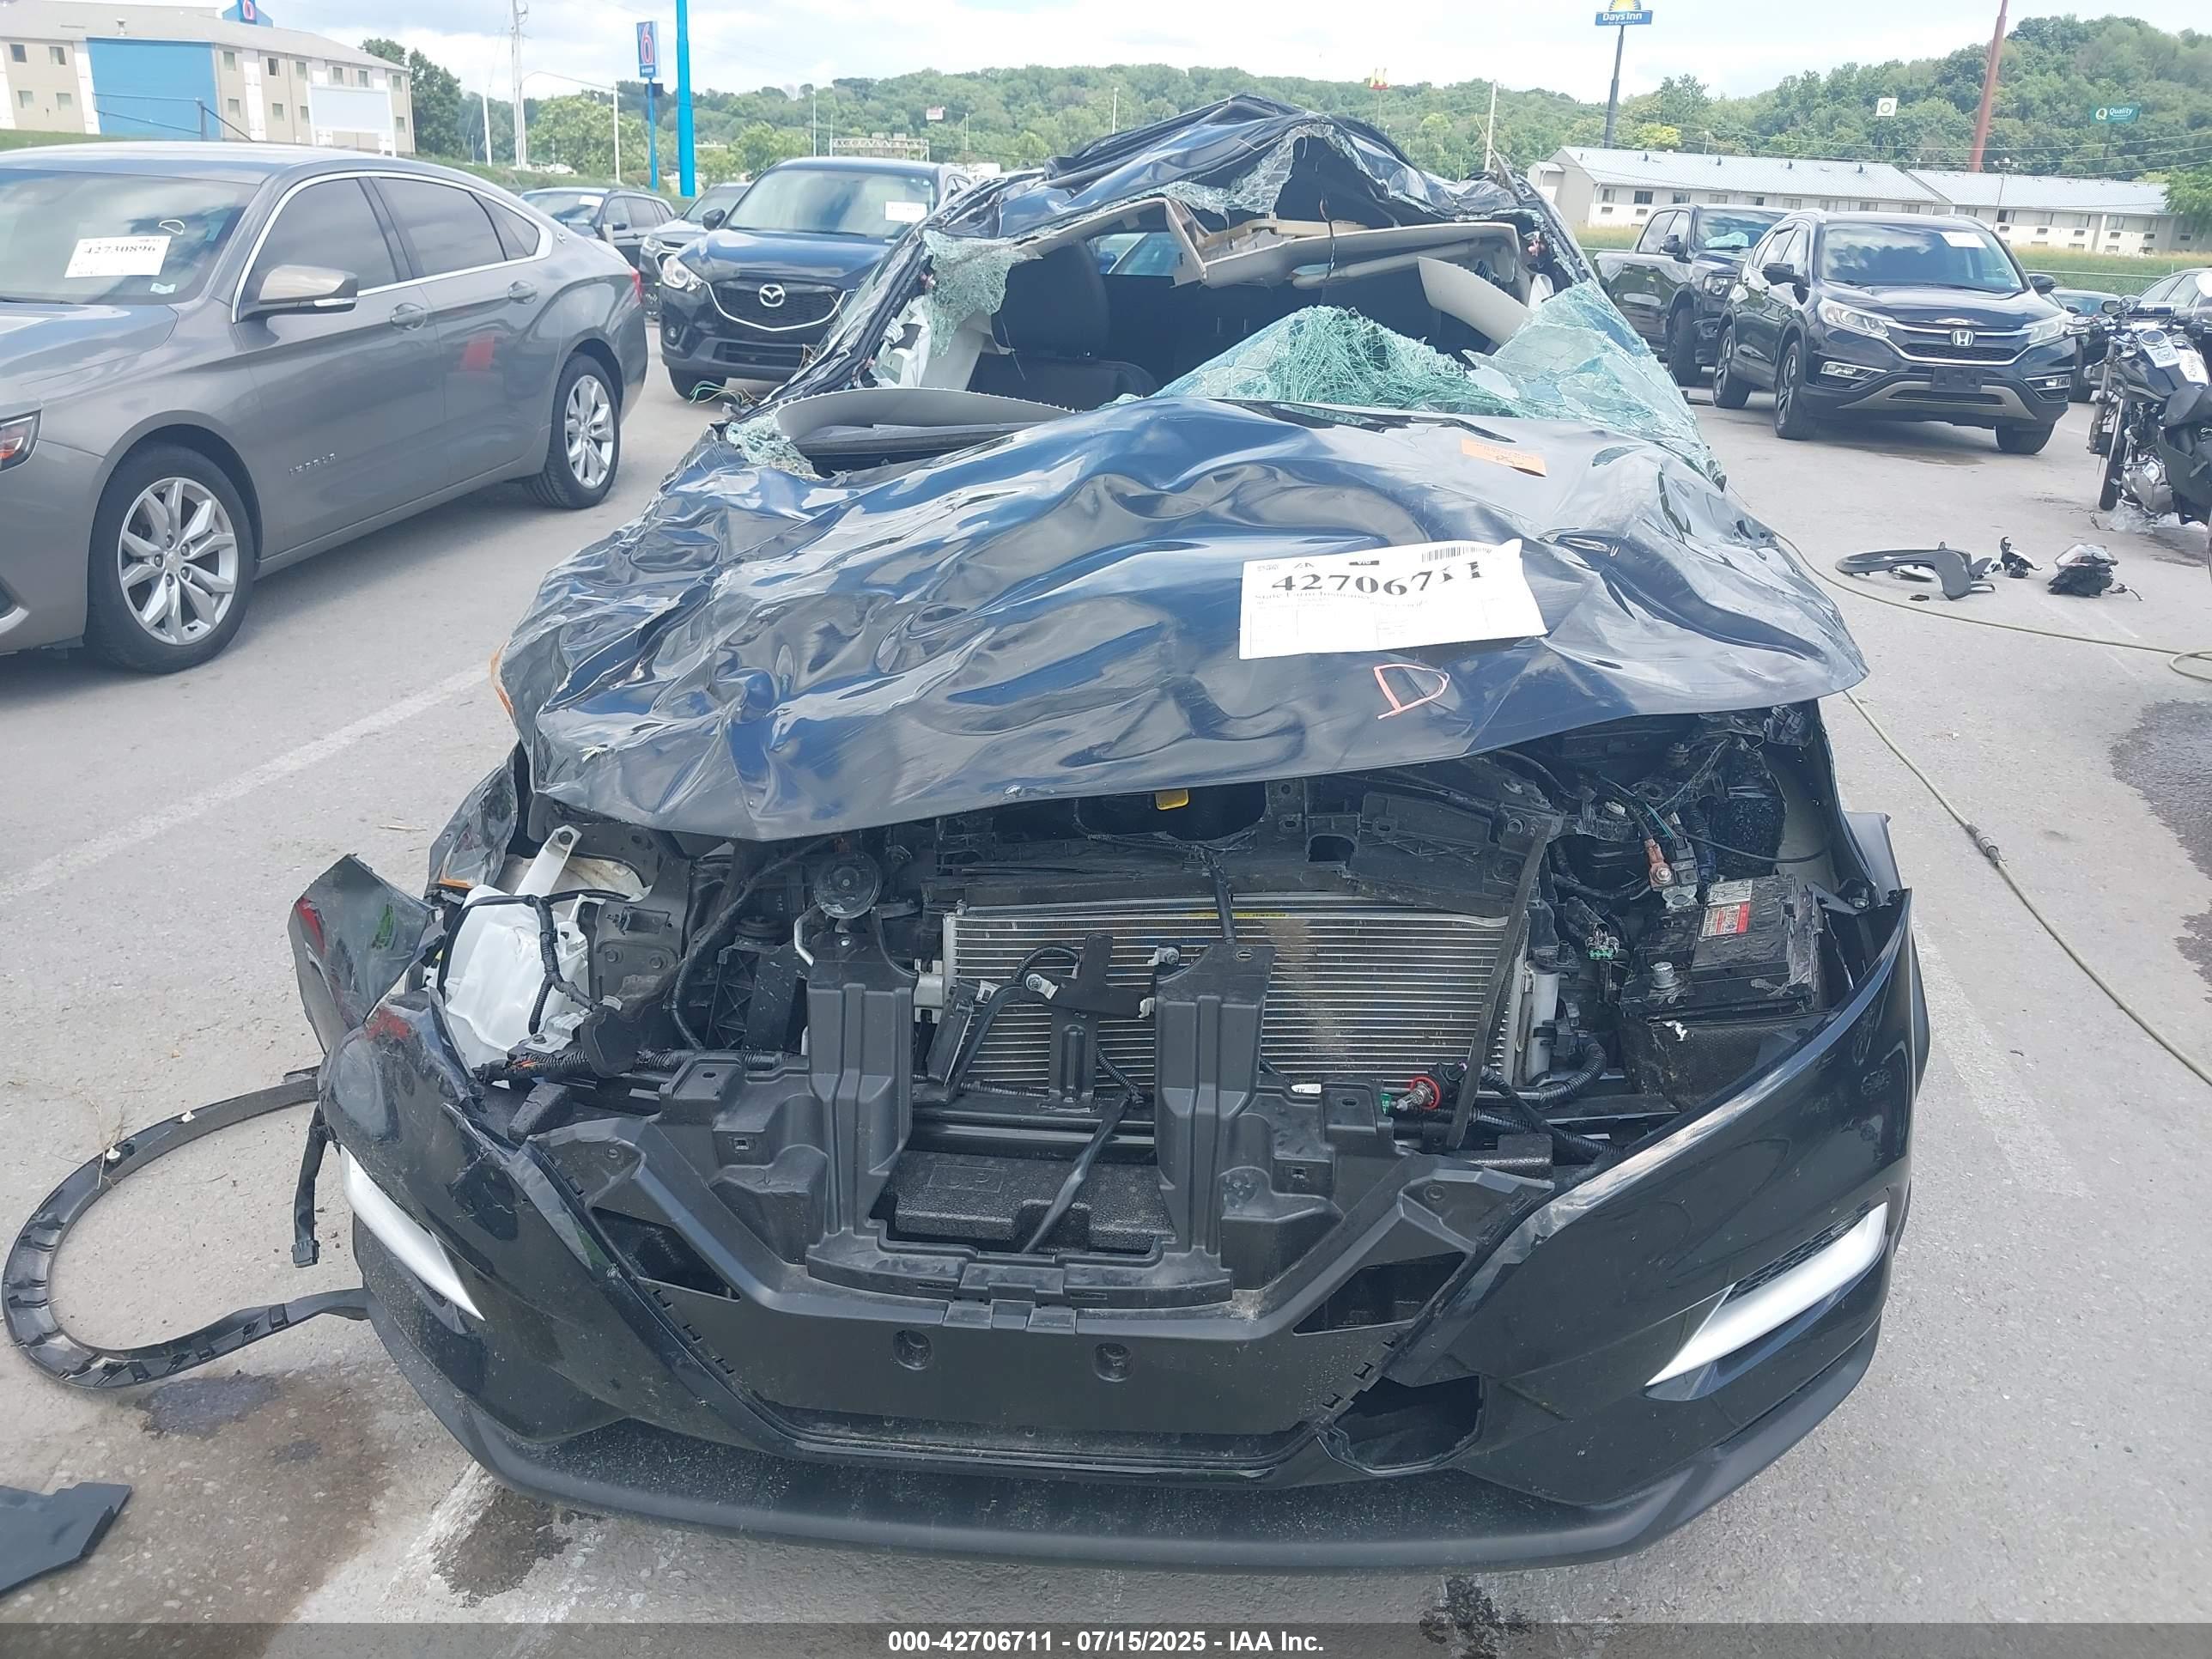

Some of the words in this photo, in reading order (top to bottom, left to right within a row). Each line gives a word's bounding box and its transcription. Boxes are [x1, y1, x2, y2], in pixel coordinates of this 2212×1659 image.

[1602, 13, 1625, 21] Days
[1626, 12, 1642, 21] Inn
[641, 22, 653, 64] 6
[2109, 107, 2134, 116] Quality
[1374, 664, 1449, 720] D
